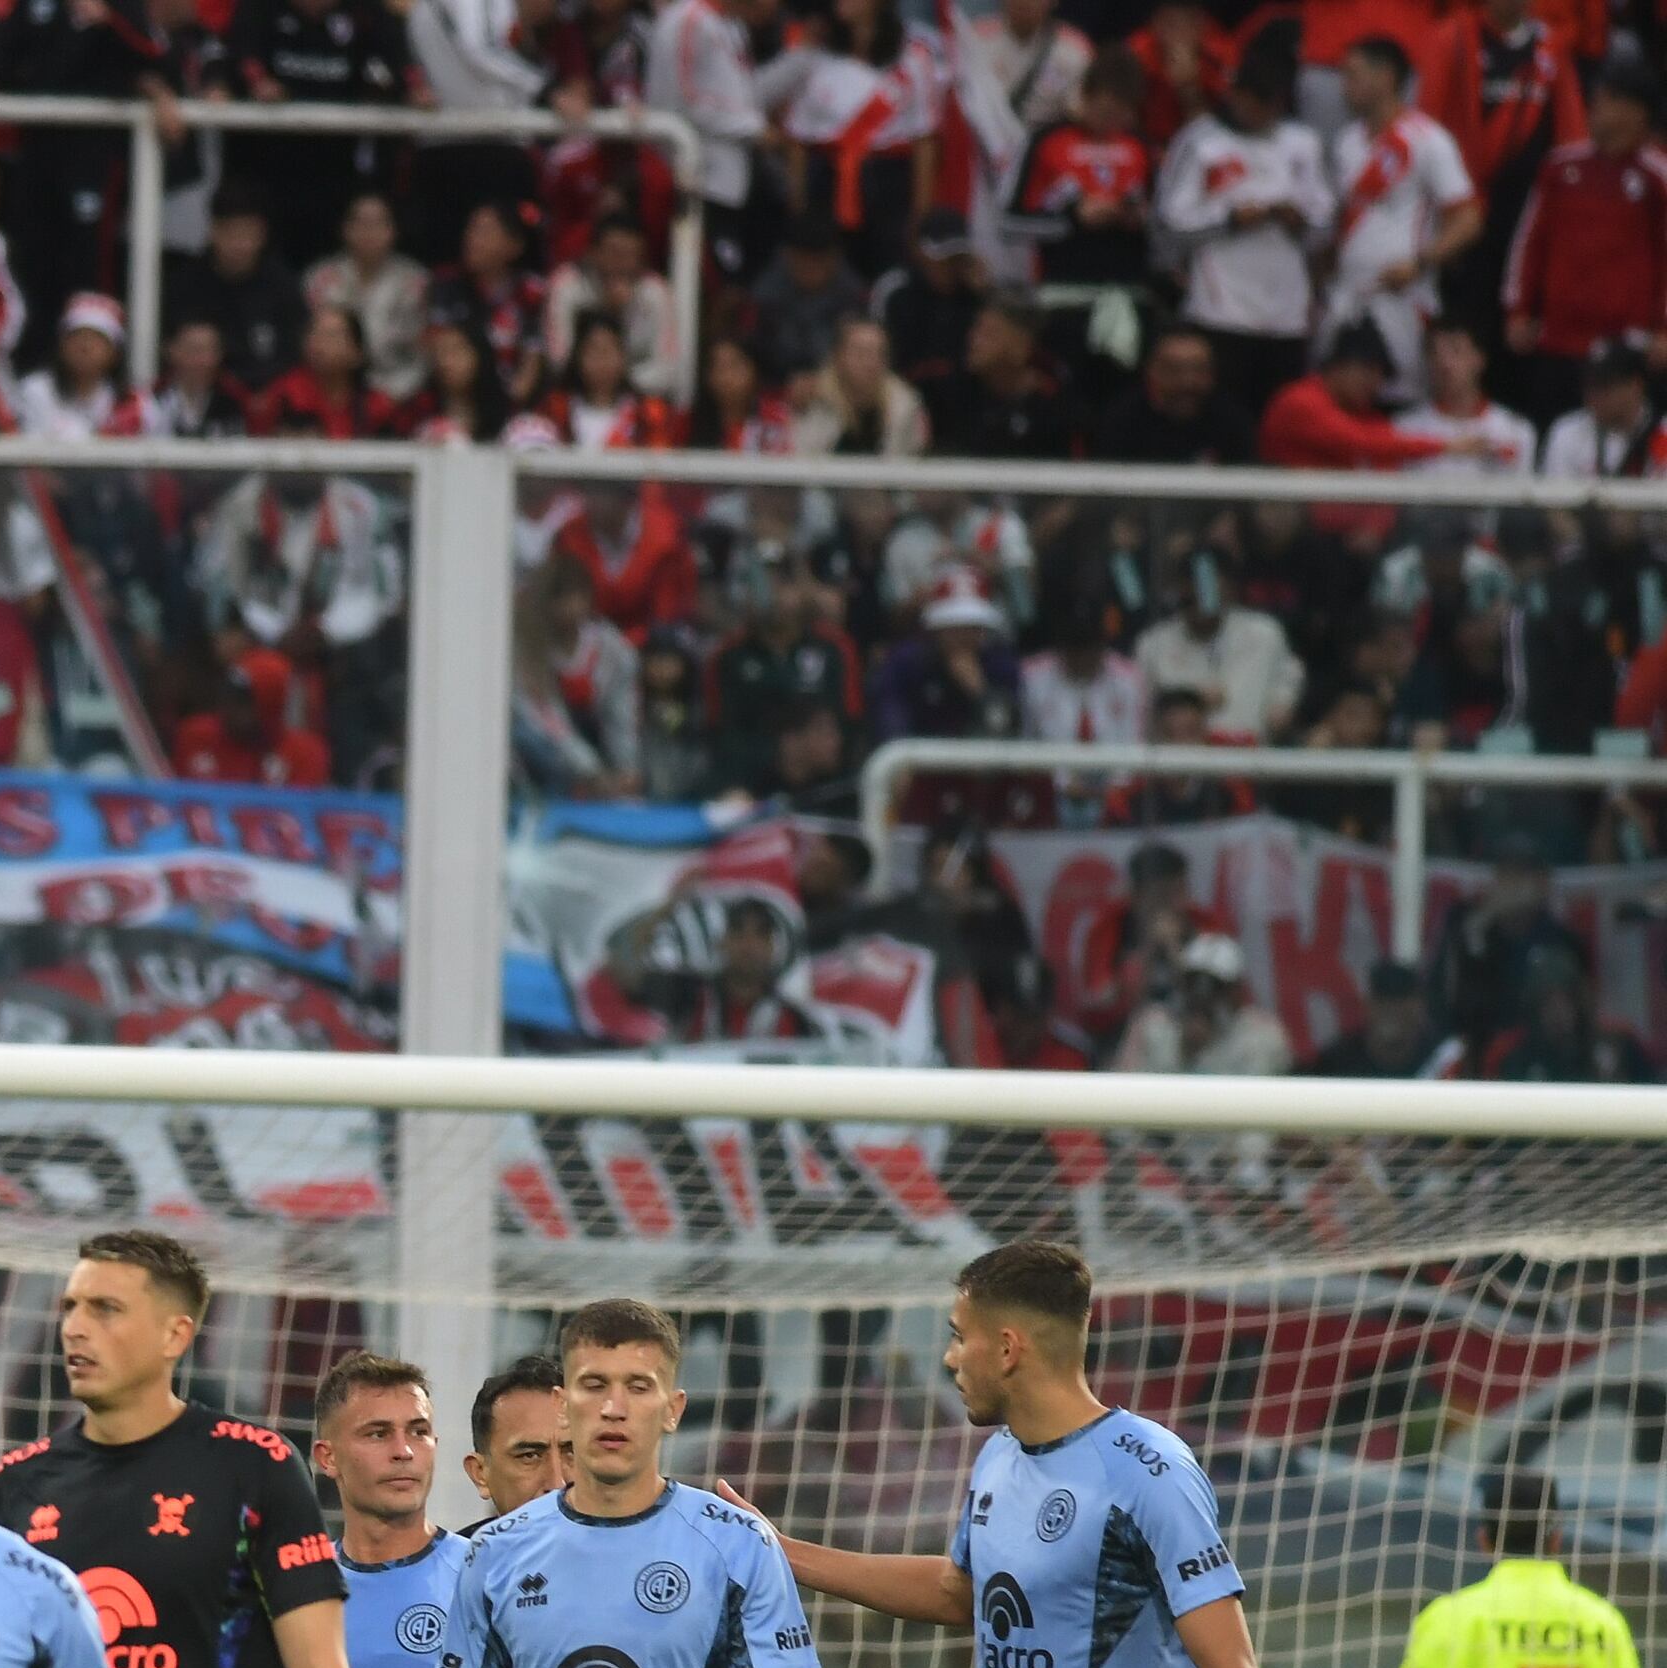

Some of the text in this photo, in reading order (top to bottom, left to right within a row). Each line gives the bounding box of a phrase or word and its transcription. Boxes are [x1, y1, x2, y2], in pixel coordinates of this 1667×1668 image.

[1113, 1433, 1170, 1477] SANOS
[464, 1510, 531, 1568] SANOS
[1176, 1544, 1231, 1582] Riii
[516, 1592, 548, 1608] errea
[1496, 1621, 1605, 1656] TECH
